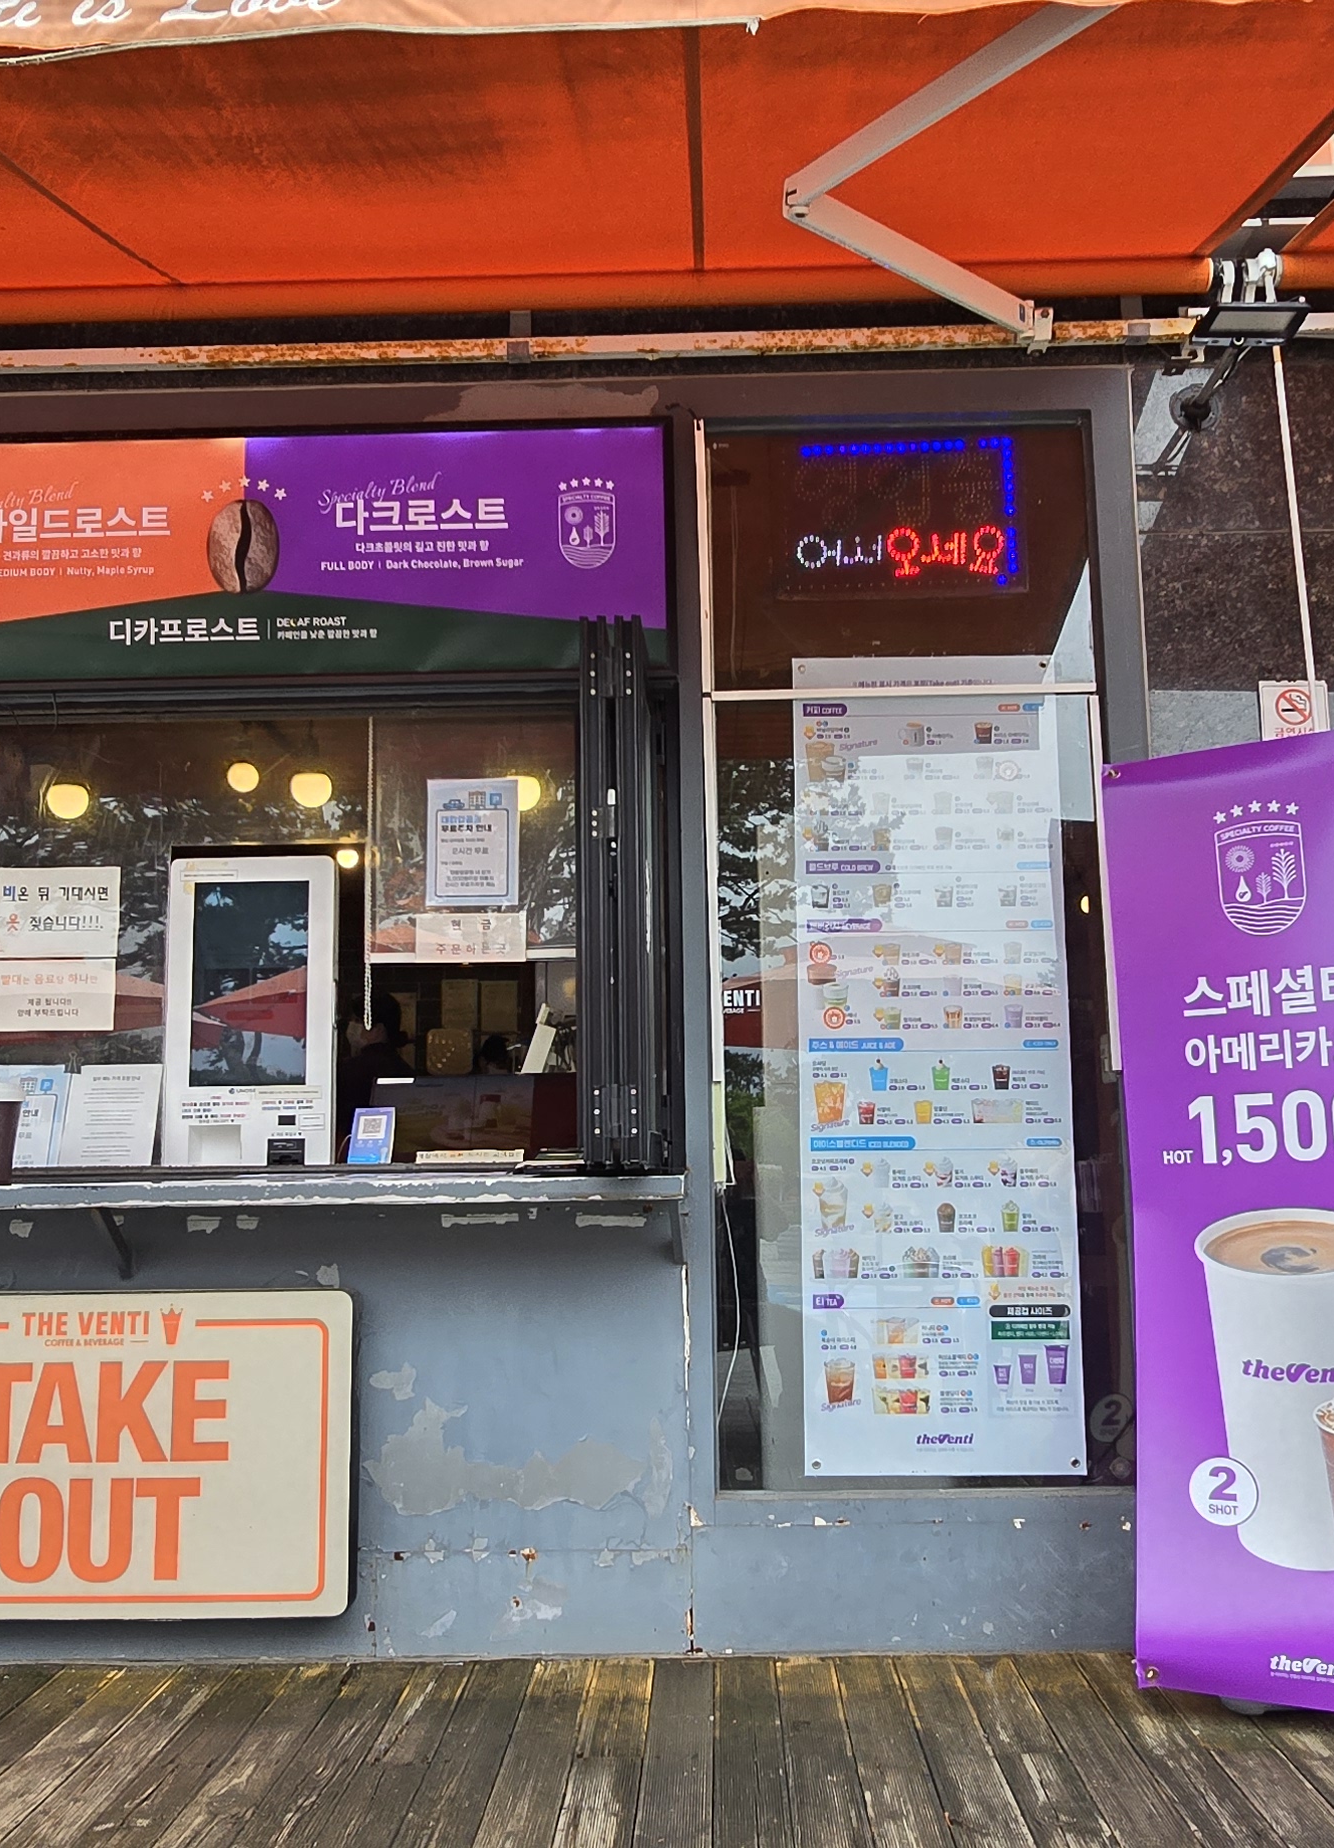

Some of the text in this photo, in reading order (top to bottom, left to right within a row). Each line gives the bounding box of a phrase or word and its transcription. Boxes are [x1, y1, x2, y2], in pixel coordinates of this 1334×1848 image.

[28, 480, 80, 505] Blend
[318, 471, 443, 514] Specialty Blend
[336, 497, 509, 535] 다크로스트
[436, 540, 455, 552] 진한
[457, 540, 477, 552] 맛과
[479, 540, 490, 551] 향
[3, 550, 40, 561] 견과류의
[80, 548, 109, 559] 고소한
[111, 548, 130, 558] 맛과
[131, 547, 142, 558] 향
[320, 556, 524, 571] FULL BODY Dark Chocolate, Brown Sugar
[29, 567, 56, 577] BODY
[67, 566, 95, 577] Nutty,
[96, 565, 126, 577] Maple
[127, 565, 155, 577] Syrup
[312, 616, 347, 627] ROAST
[109, 617, 260, 646] 디카프로스트
[839, 739, 878, 751] Signature
[475, 823, 493, 833] 안내
[1220, 824, 1295, 840] SPECIALTY COFFEE
[2, 885, 109, 902] 비온 뒤 기대시면
[6, 913, 20, 933] 옷
[34, 1008, 79, 1017] 부탁드립니다
[811, 1040, 828, 1050] 주스
[836, 1040, 859, 1050] 에이드
[861, 1041, 878, 1050] JUICE
[884, 1041, 896, 1049] ADE
[22, 1108, 40, 1118] 안내
[811, 1118, 851, 1132] Signature
[813, 1138, 867, 1149] 아이스블렌디드
[1162, 1149, 1194, 1166] HOT
[814, 1223, 855, 1238] Signature
[826, 1298, 839, 1307] TEA
[1030, 1305, 1053, 1316] 사이즈
[22, 1310, 151, 1337] THE VENTI
[44, 1337, 125, 1348] COFFEE & BEVERAGE
[916, 1432, 974, 1446] theVenti
[1208, 1465, 1238, 1503] 2
[1207, 1504, 1239, 1517] SHOT
